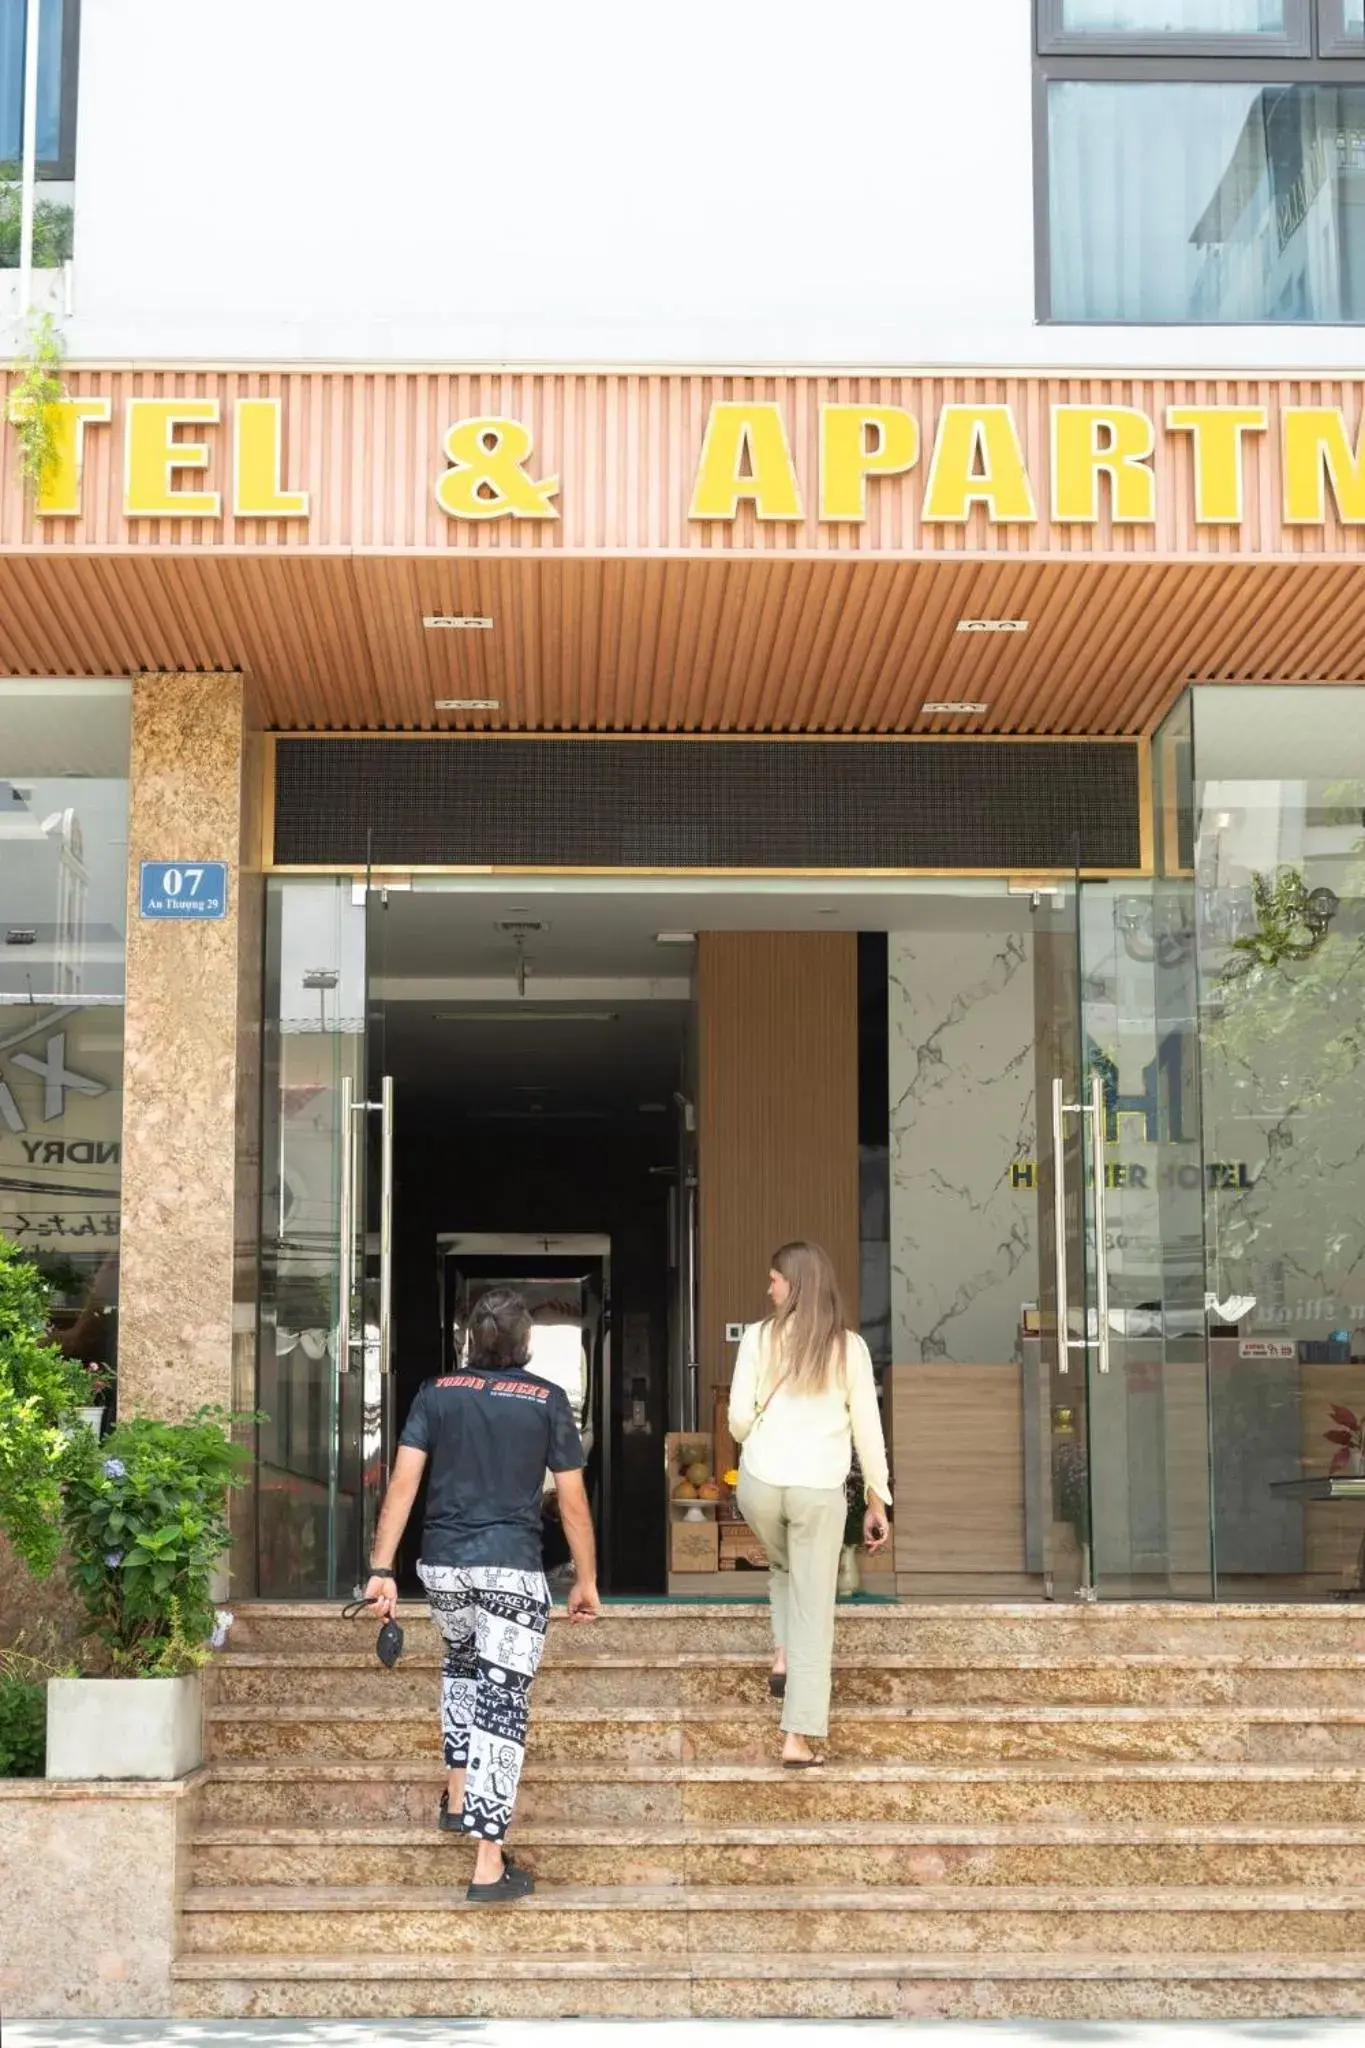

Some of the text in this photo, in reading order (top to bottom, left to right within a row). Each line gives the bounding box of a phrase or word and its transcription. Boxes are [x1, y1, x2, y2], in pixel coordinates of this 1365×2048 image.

[14, 397, 1365, 524] TEL & APARTM
[163, 868, 205, 896] 07
[148, 899, 163, 909] An
[207, 899, 219, 909] 29
[480, 1591, 532, 1610] HOCKEY
